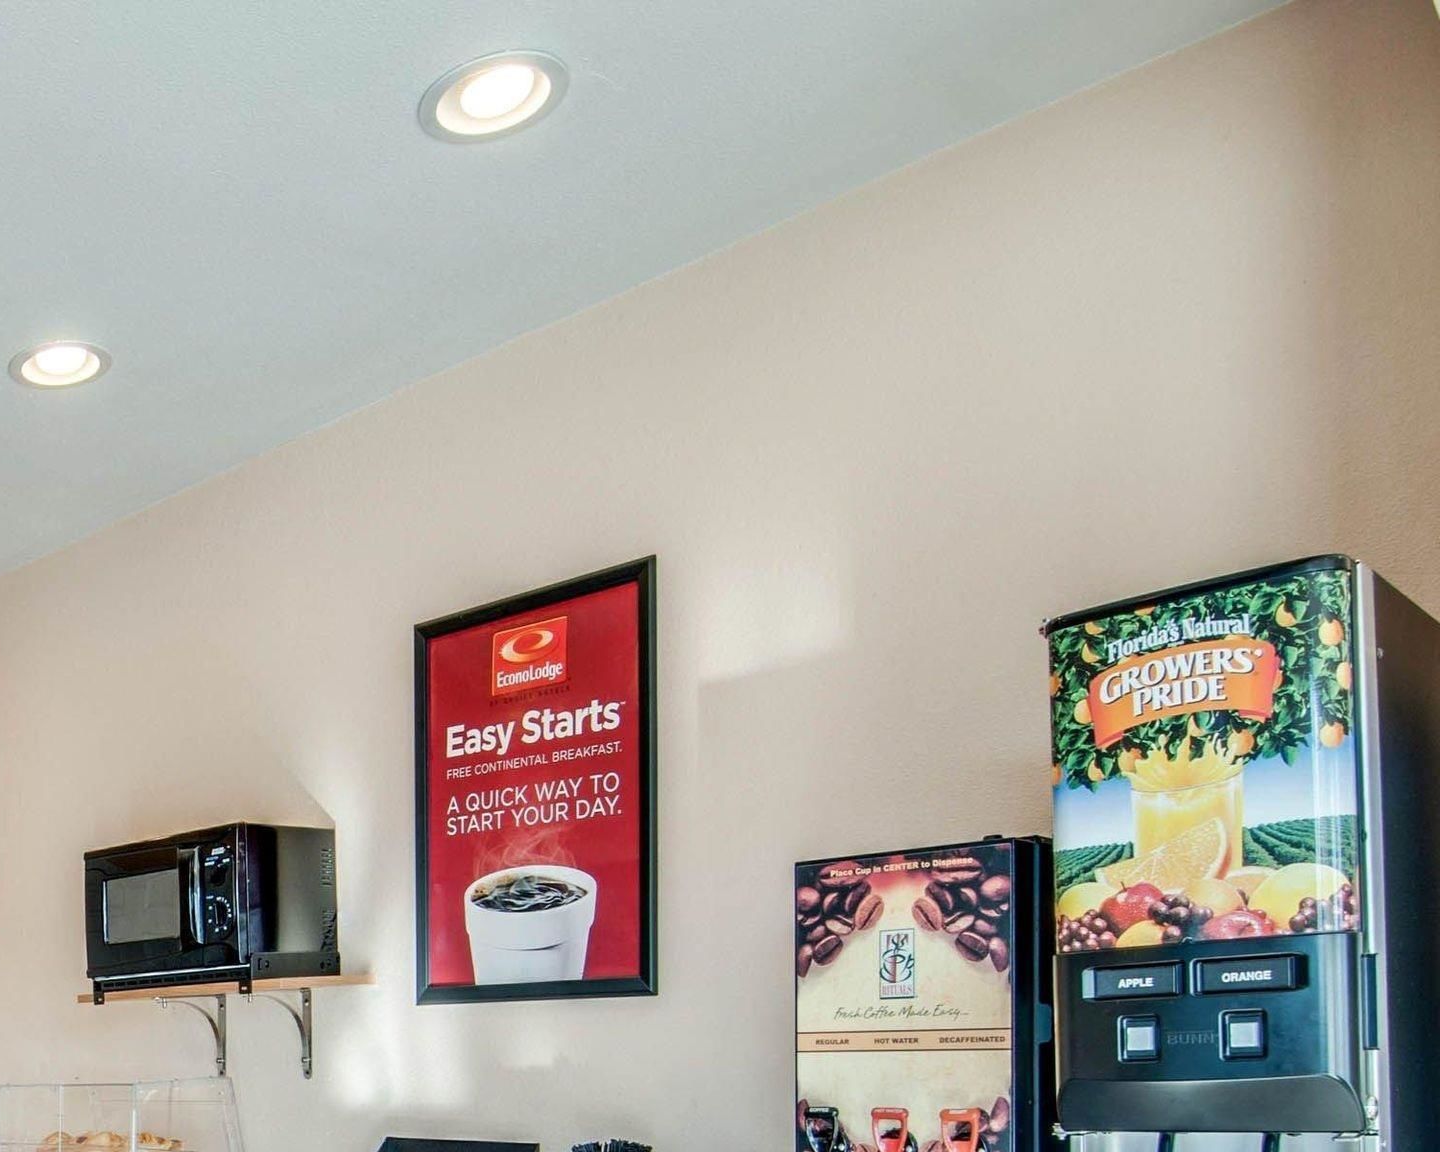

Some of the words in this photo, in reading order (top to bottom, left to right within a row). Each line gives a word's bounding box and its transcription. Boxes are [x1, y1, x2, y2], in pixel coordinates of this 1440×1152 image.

[1107, 622, 1180, 664] Florida's
[1182, 613, 1253, 640] Natural
[496, 661, 563, 688] EconoLodge
[1133, 675, 1227, 717] PRIDE
[446, 720, 516, 758] Easy
[521, 699, 621, 744] Starts
[446, 765, 472, 780] FREE
[474, 753, 548, 776] CONTINENTAL
[552, 741, 623, 763] BREAKFAST.
[446, 795, 460, 815] A
[465, 784, 528, 811] QUICK
[535, 777, 583, 801] WAY
[590, 772, 620, 795] TO
[446, 810, 505, 836] START
[511, 802, 569, 827] YOUR
[576, 794, 622, 819] DAY.
[829, 868, 853, 878] Place
[855, 866, 872, 877] Cup
[873, 865, 882, 873] in
[883, 861, 919, 872] CENTER
[920, 860, 931, 868] to
[932, 856, 974, 868] Dispense
[1117, 976, 1154, 989] APPLE
[1221, 969, 1273, 983] ORANGE
[833, 1006, 862, 1020] Fresh
[863, 1005, 896, 1020] Coffee
[898, 1004, 932, 1018] Made
[815, 1038, 850, 1046] REGULAR
[873, 1037, 890, 1045] HOT
[891, 1036, 919, 1045] WATER
[939, 1036, 1006, 1045] DECAFFEINATED
[1166, 1031, 1215, 1046] BUNN
